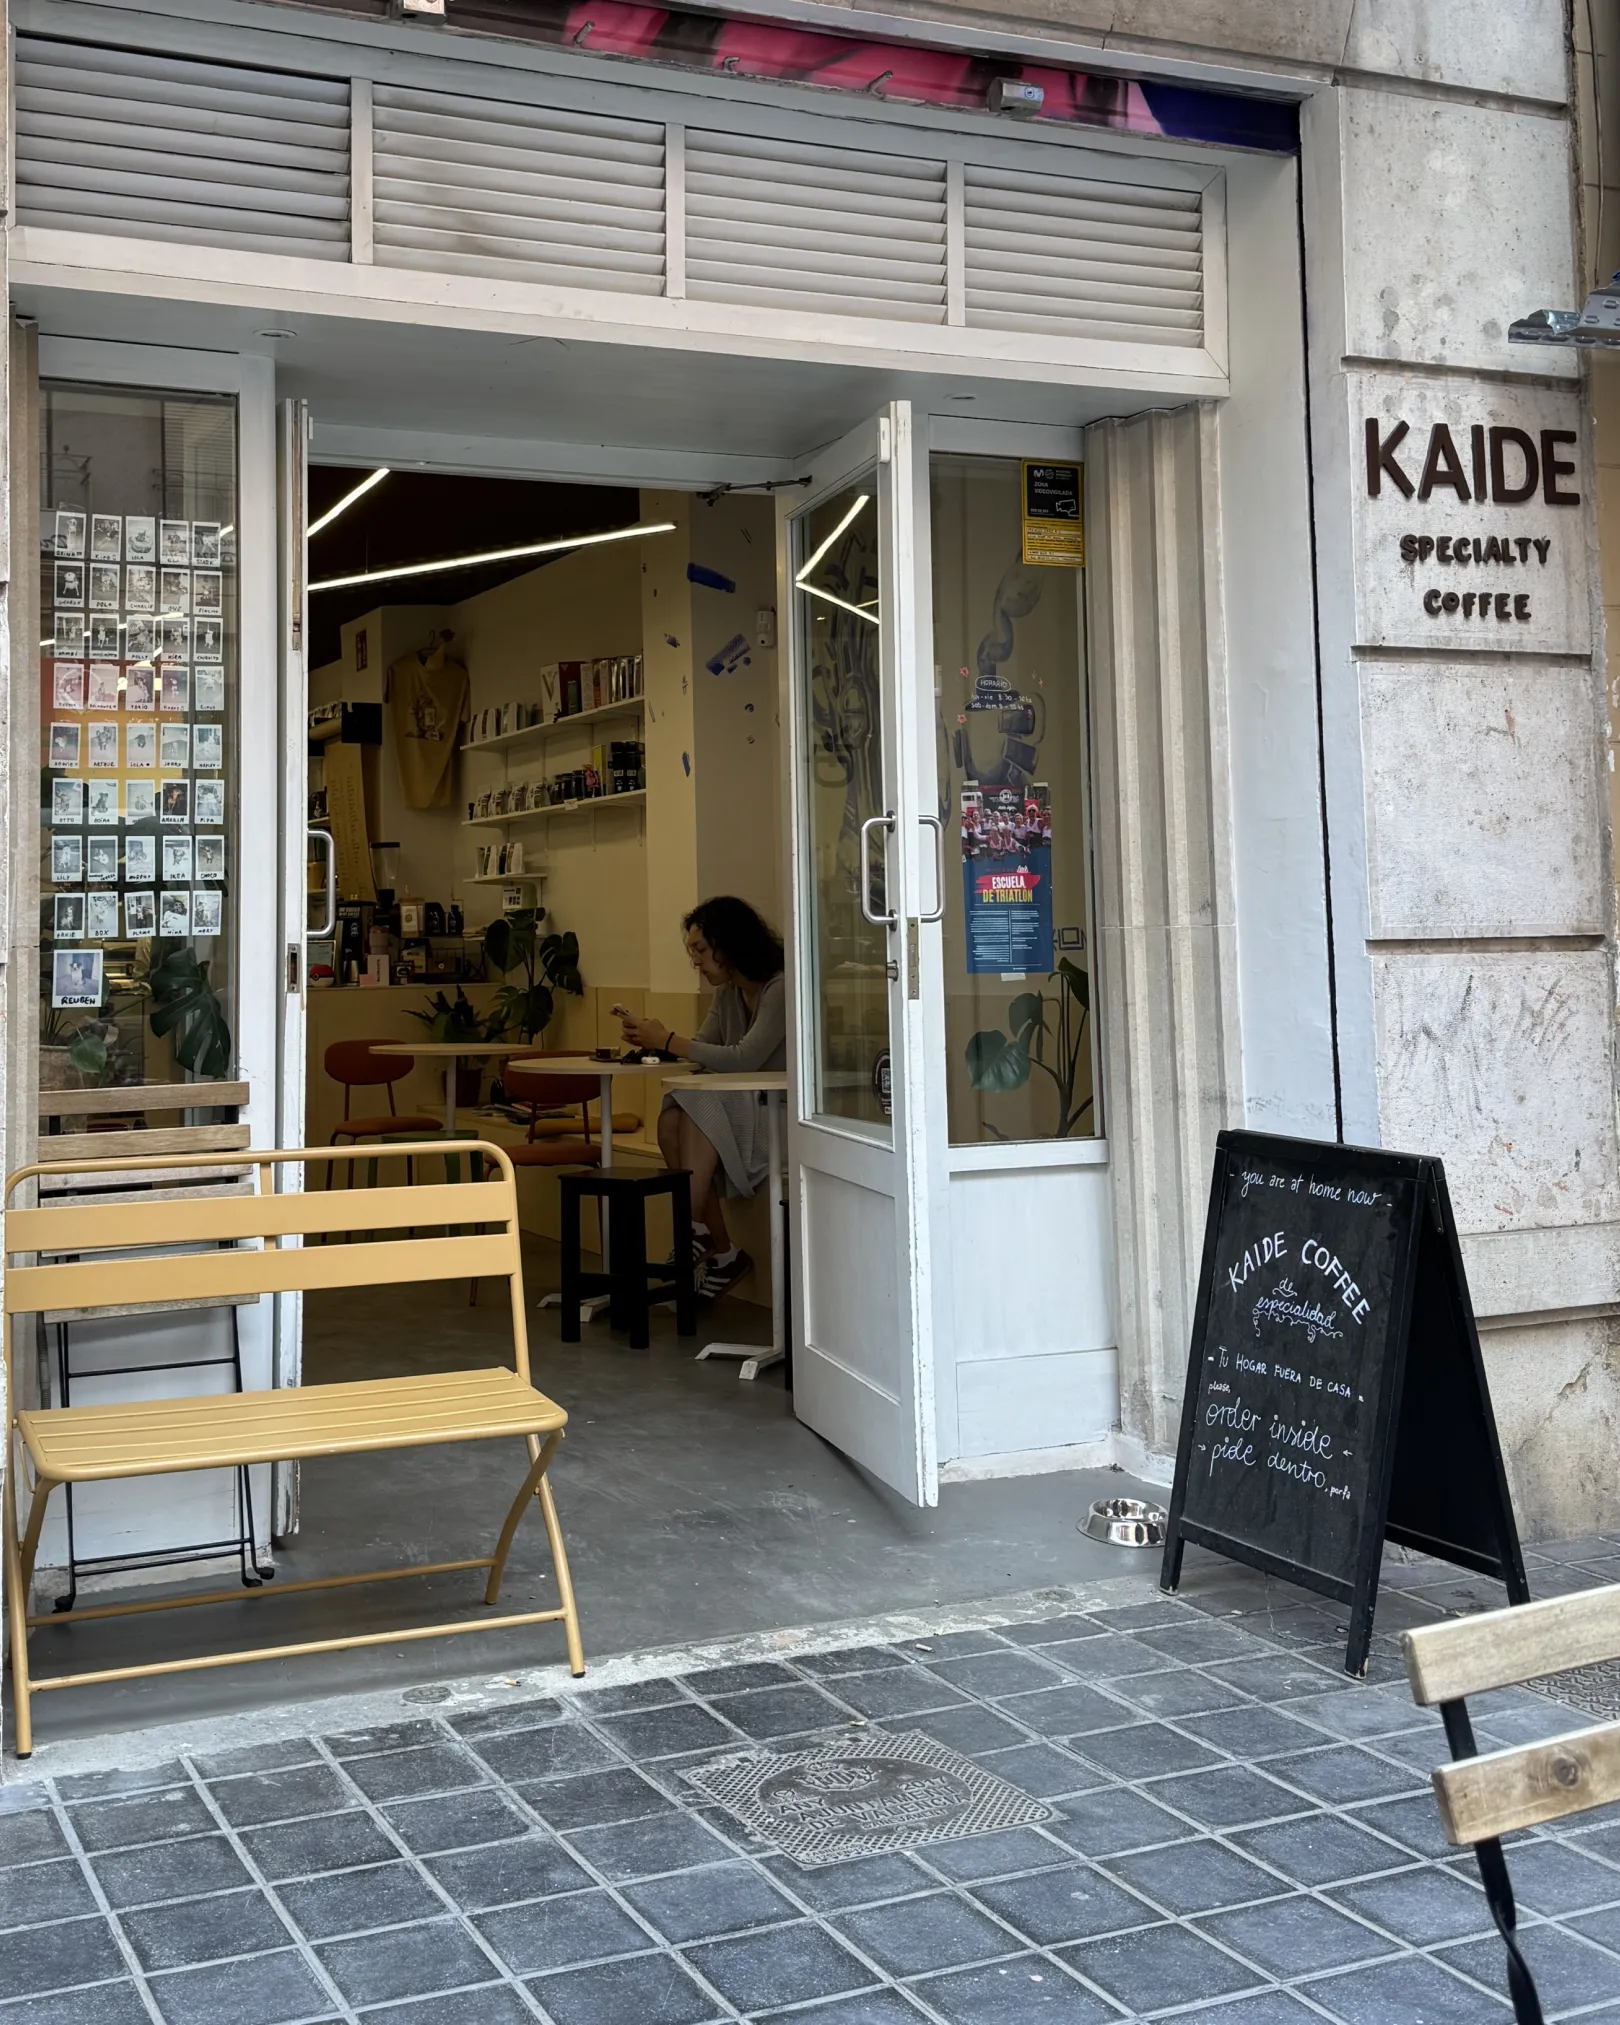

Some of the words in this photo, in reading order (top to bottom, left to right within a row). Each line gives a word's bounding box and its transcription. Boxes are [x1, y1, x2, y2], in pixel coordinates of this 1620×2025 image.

[1365, 417, 1581, 505] KAIDE
[1399, 534, 1551, 564] SPECIALTY
[1423, 588, 1532, 620] COFFEE
[982, 889, 994, 903] DE
[992, 875, 1026, 890] ESCUELA
[61, 995, 96, 1005] REUBEN
[1241, 1170, 1264, 1197] you
[1269, 1174, 1285, 1188] are
[1290, 1173, 1304, 1193] at
[1309, 1174, 1341, 1200] home
[1347, 1188, 1382, 1206] now
[1228, 1231, 1287, 1292] KAIDE
[1301, 1239, 1371, 1325] COFFEE
[1278, 1277, 1294, 1293] de
[1256, 1296, 1337, 1329] especialidad
[1236, 1353, 1267, 1375] HOGAR
[1274, 1364, 1301, 1383] FUERA
[1309, 1375, 1322, 1390] DE
[1327, 1382, 1352, 1398] CASA
[1205, 1397, 1261, 1431] order
[1269, 1414, 1333, 1459] inside
[1209, 1436, 1256, 1477] pide
[780, 1798, 825, 1814] ANY
[902, 1775, 947, 1791] 2017
[800, 1787, 957, 1822] AJUNTAMENT
[810, 1818, 844, 1831] DE
[851, 1795, 968, 1821] VALENCIA
